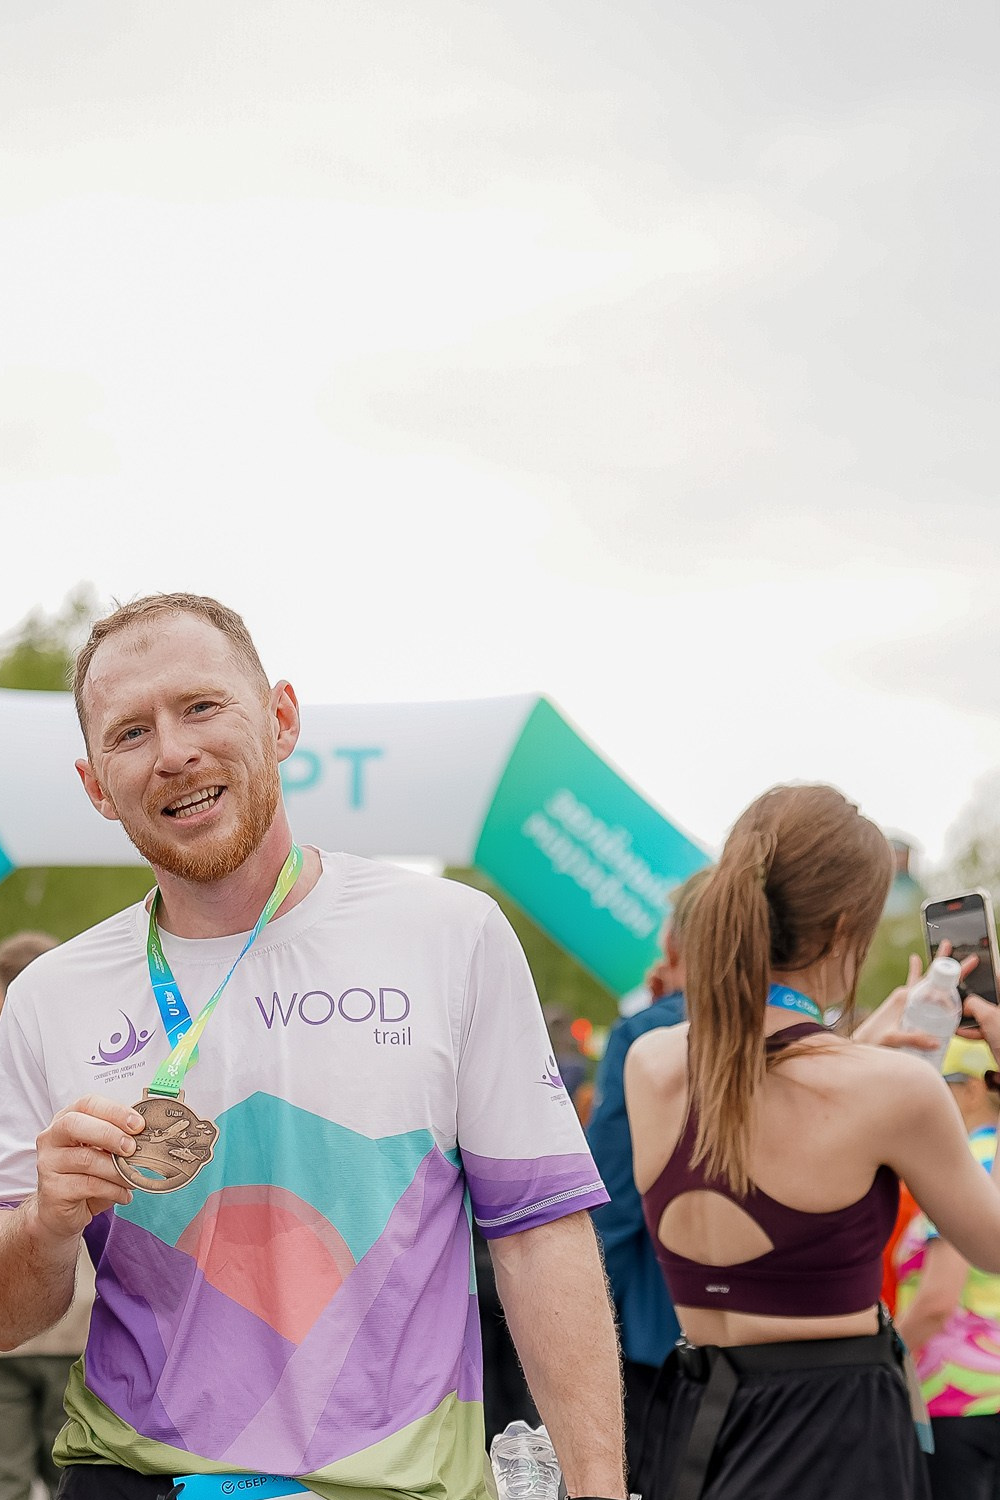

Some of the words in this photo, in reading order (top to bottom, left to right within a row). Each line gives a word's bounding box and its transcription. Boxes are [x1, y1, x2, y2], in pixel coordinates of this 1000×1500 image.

[254, 987, 411, 1030] WOOD
[373, 1026, 412, 1046] trail
[166, 1109, 184, 1118] Utair
[237, 1476, 268, 1490] СБЕР
